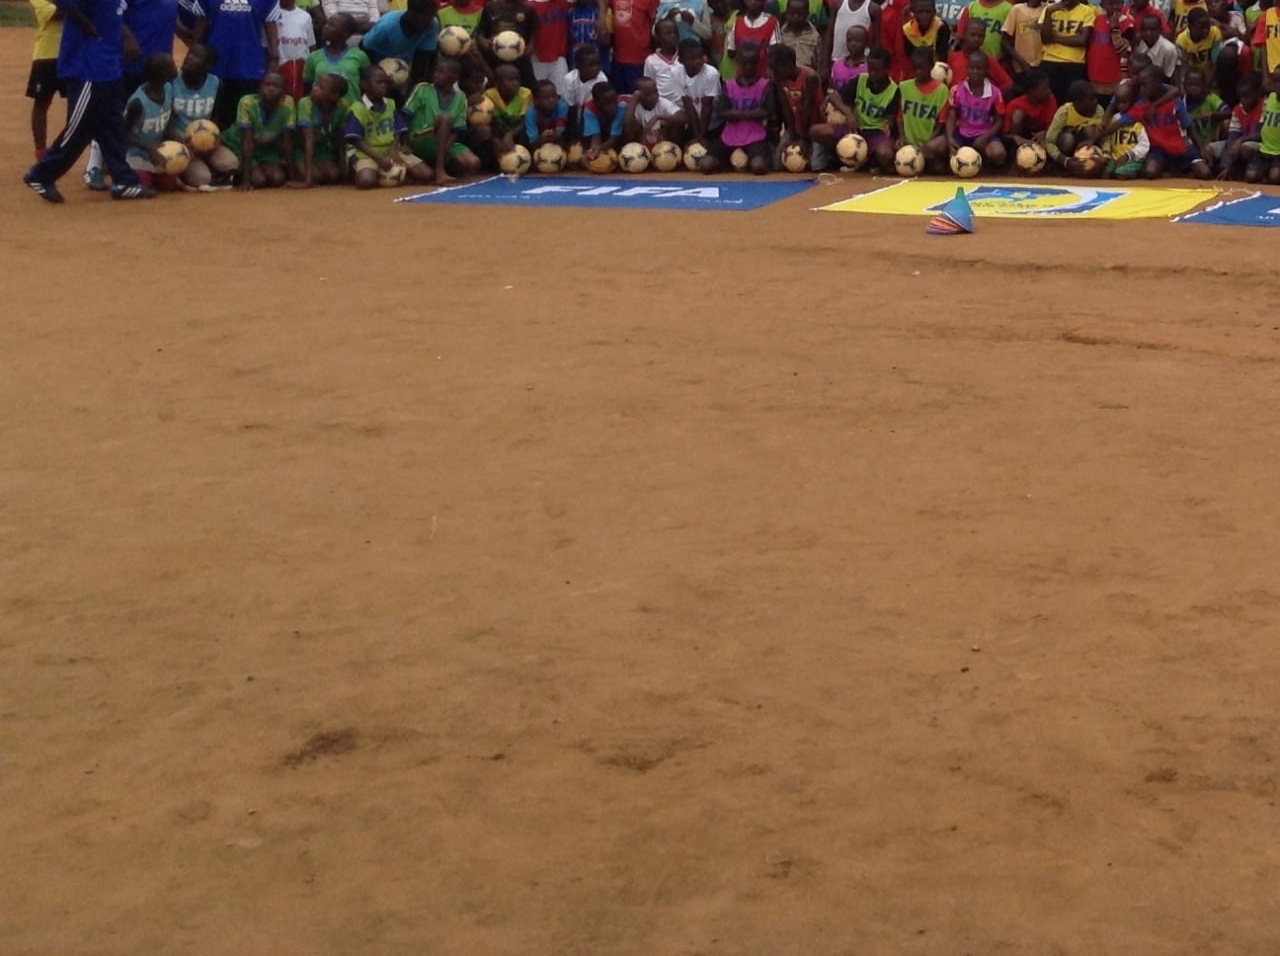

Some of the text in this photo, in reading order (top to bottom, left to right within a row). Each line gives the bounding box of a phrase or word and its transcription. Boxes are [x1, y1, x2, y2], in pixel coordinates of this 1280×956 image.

[219, 3, 252, 12] adidas
[935, 3, 962, 20] FIF
[903, 99, 938, 121] FIFA
[1114, 128, 1139, 146] IFA
[521, 185, 720, 198] FIFA
